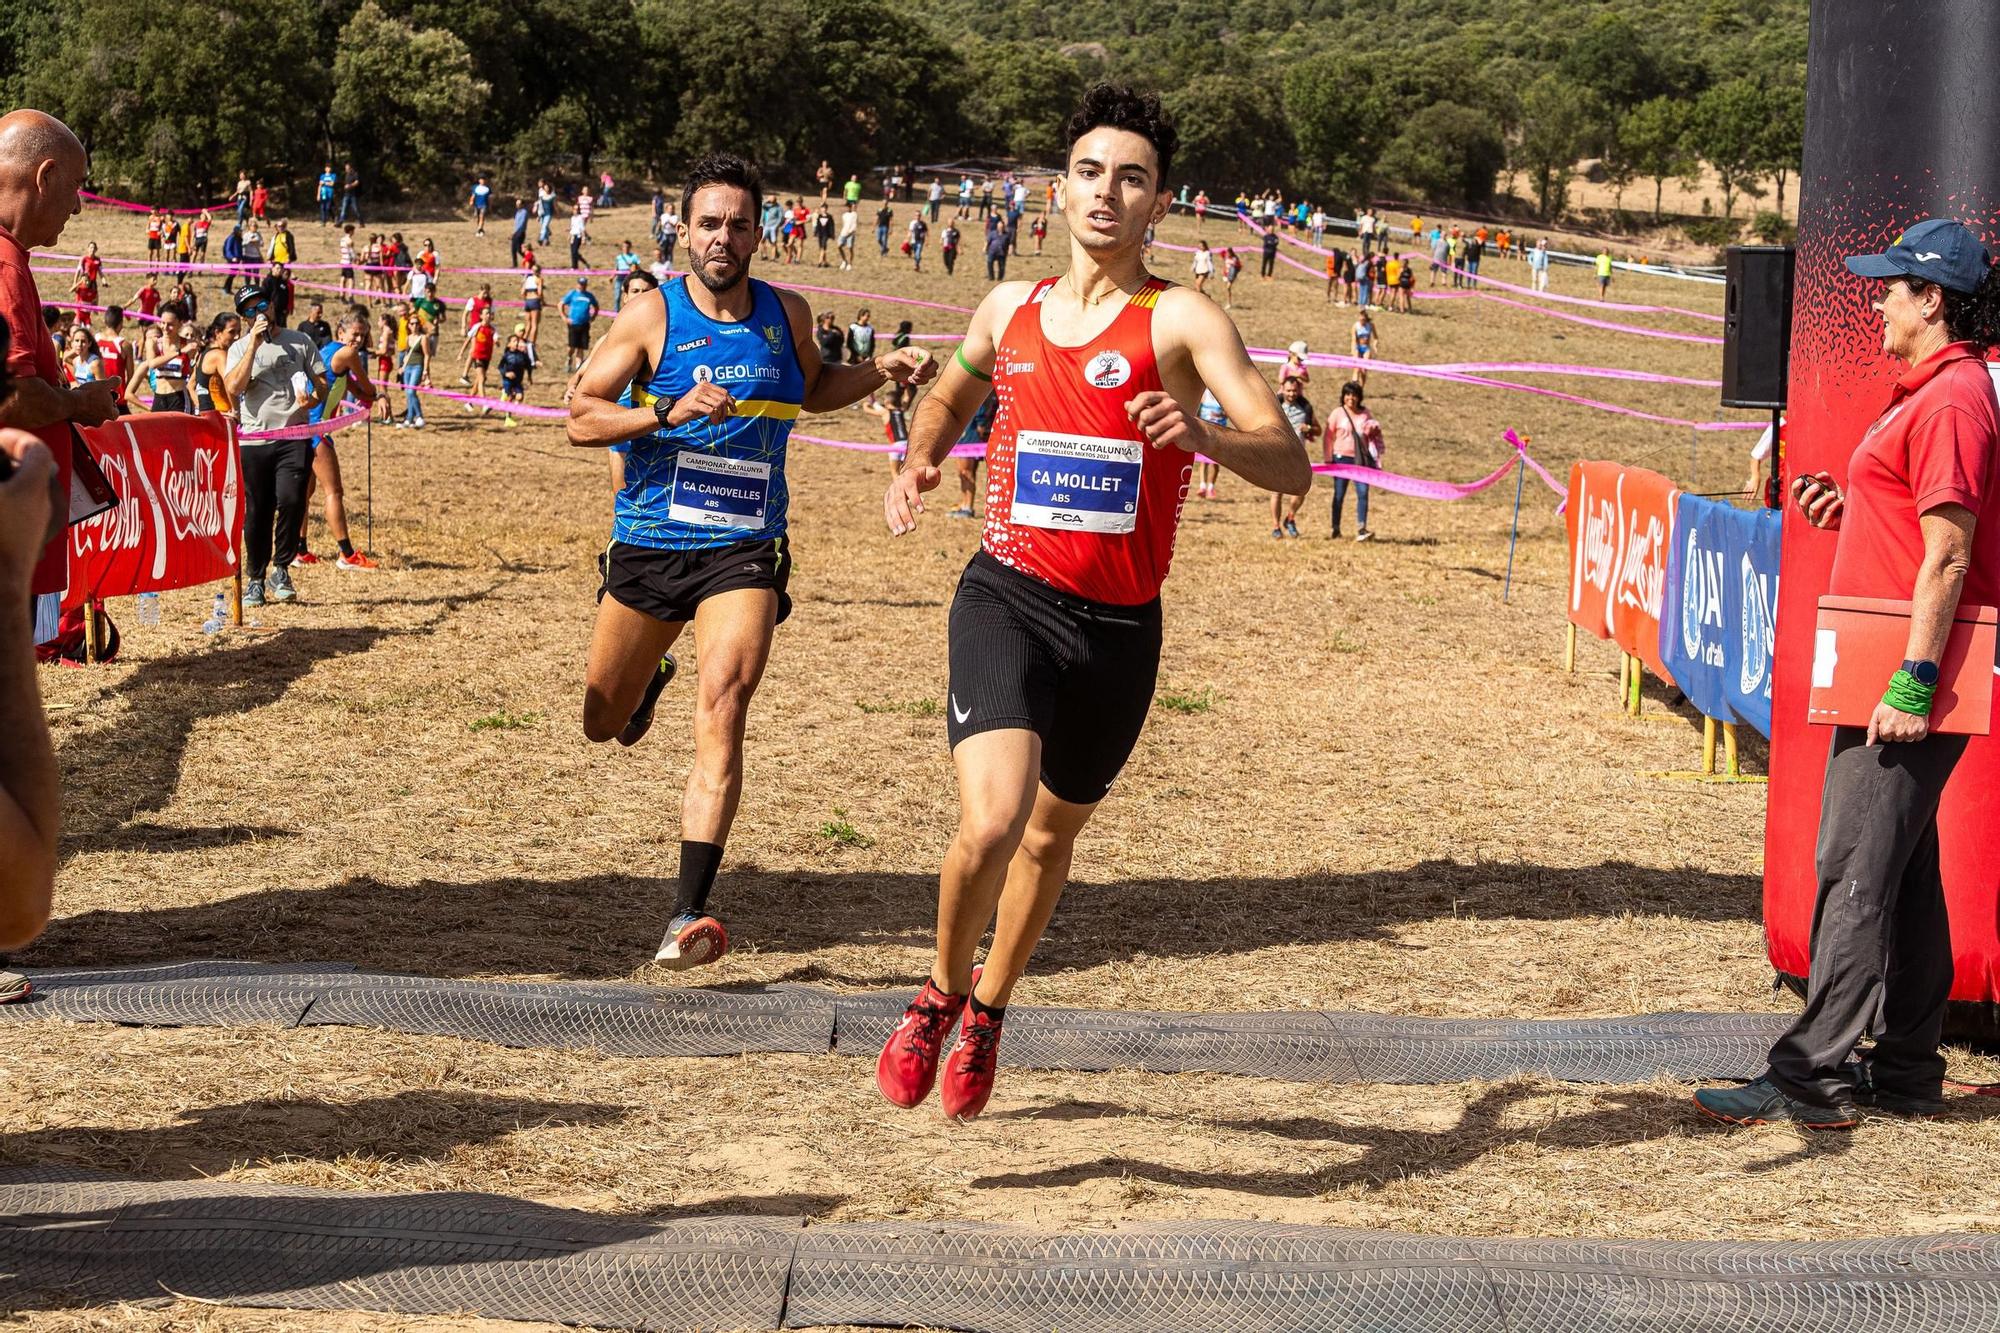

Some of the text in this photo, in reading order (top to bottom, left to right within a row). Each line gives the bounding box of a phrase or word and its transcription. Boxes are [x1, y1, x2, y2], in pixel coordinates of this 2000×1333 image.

[677, 338, 707, 352] SAPLEX
[714, 363, 781, 380] GEOLímits
[1026, 438, 1133, 456] CAMPIONAT CATALUNYA
[685, 457, 764, 474] CAMPIONAT CATALUNYA
[1031, 469, 1122, 492] CA MOLLET
[682, 481, 761, 501] CA CANOVELLES
[1050, 493, 1071, 503] ABS
[704, 499, 720, 508] ABS
